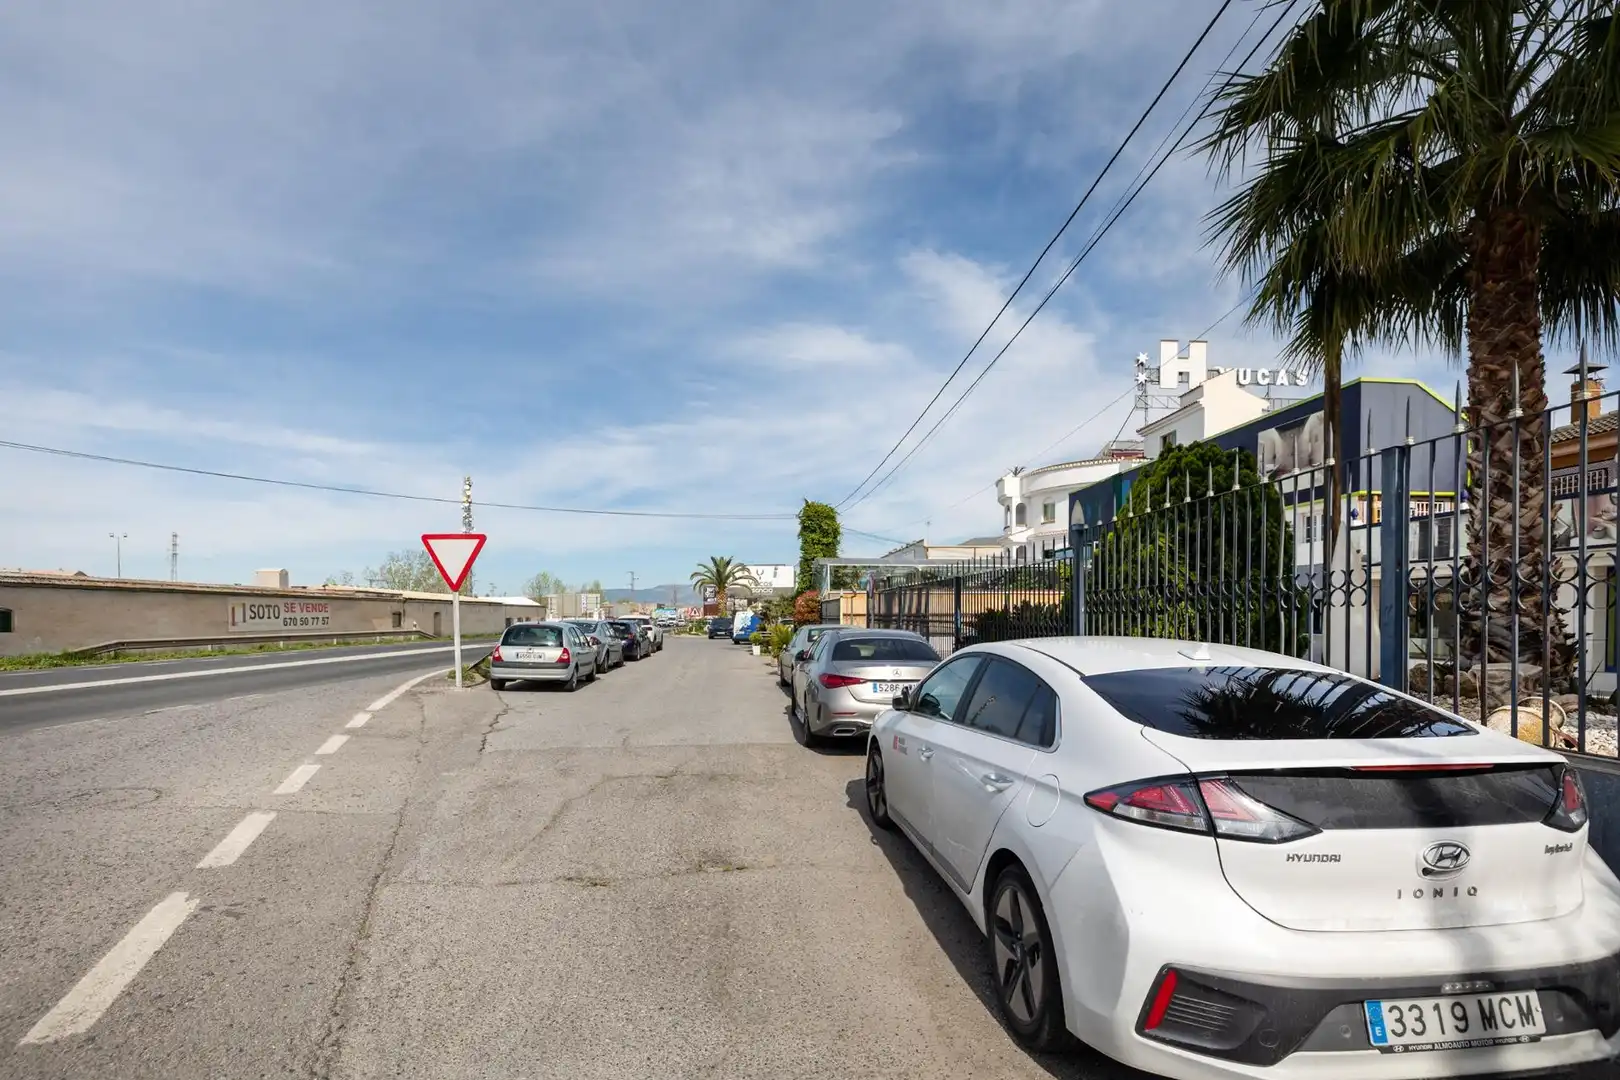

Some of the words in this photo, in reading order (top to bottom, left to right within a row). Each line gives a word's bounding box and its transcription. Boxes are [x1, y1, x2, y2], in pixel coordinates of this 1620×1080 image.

[1160, 340, 1208, 389] H
[1212, 366, 1309, 386] UCAS
[249, 604, 281, 620] SOTO
[283, 602, 297, 613] SE
[299, 602, 329, 613] VENDE
[283, 617, 298, 627] 670
[300, 616, 309, 626] 50
[311, 617, 320, 626] 77
[321, 616, 329, 625] 57
[1286, 853, 1342, 863] HYUNDAI
[1388, 1001, 1469, 1037] 3319
[1477, 995, 1536, 1031] MCM
[1374, 1026, 1383, 1037] E
